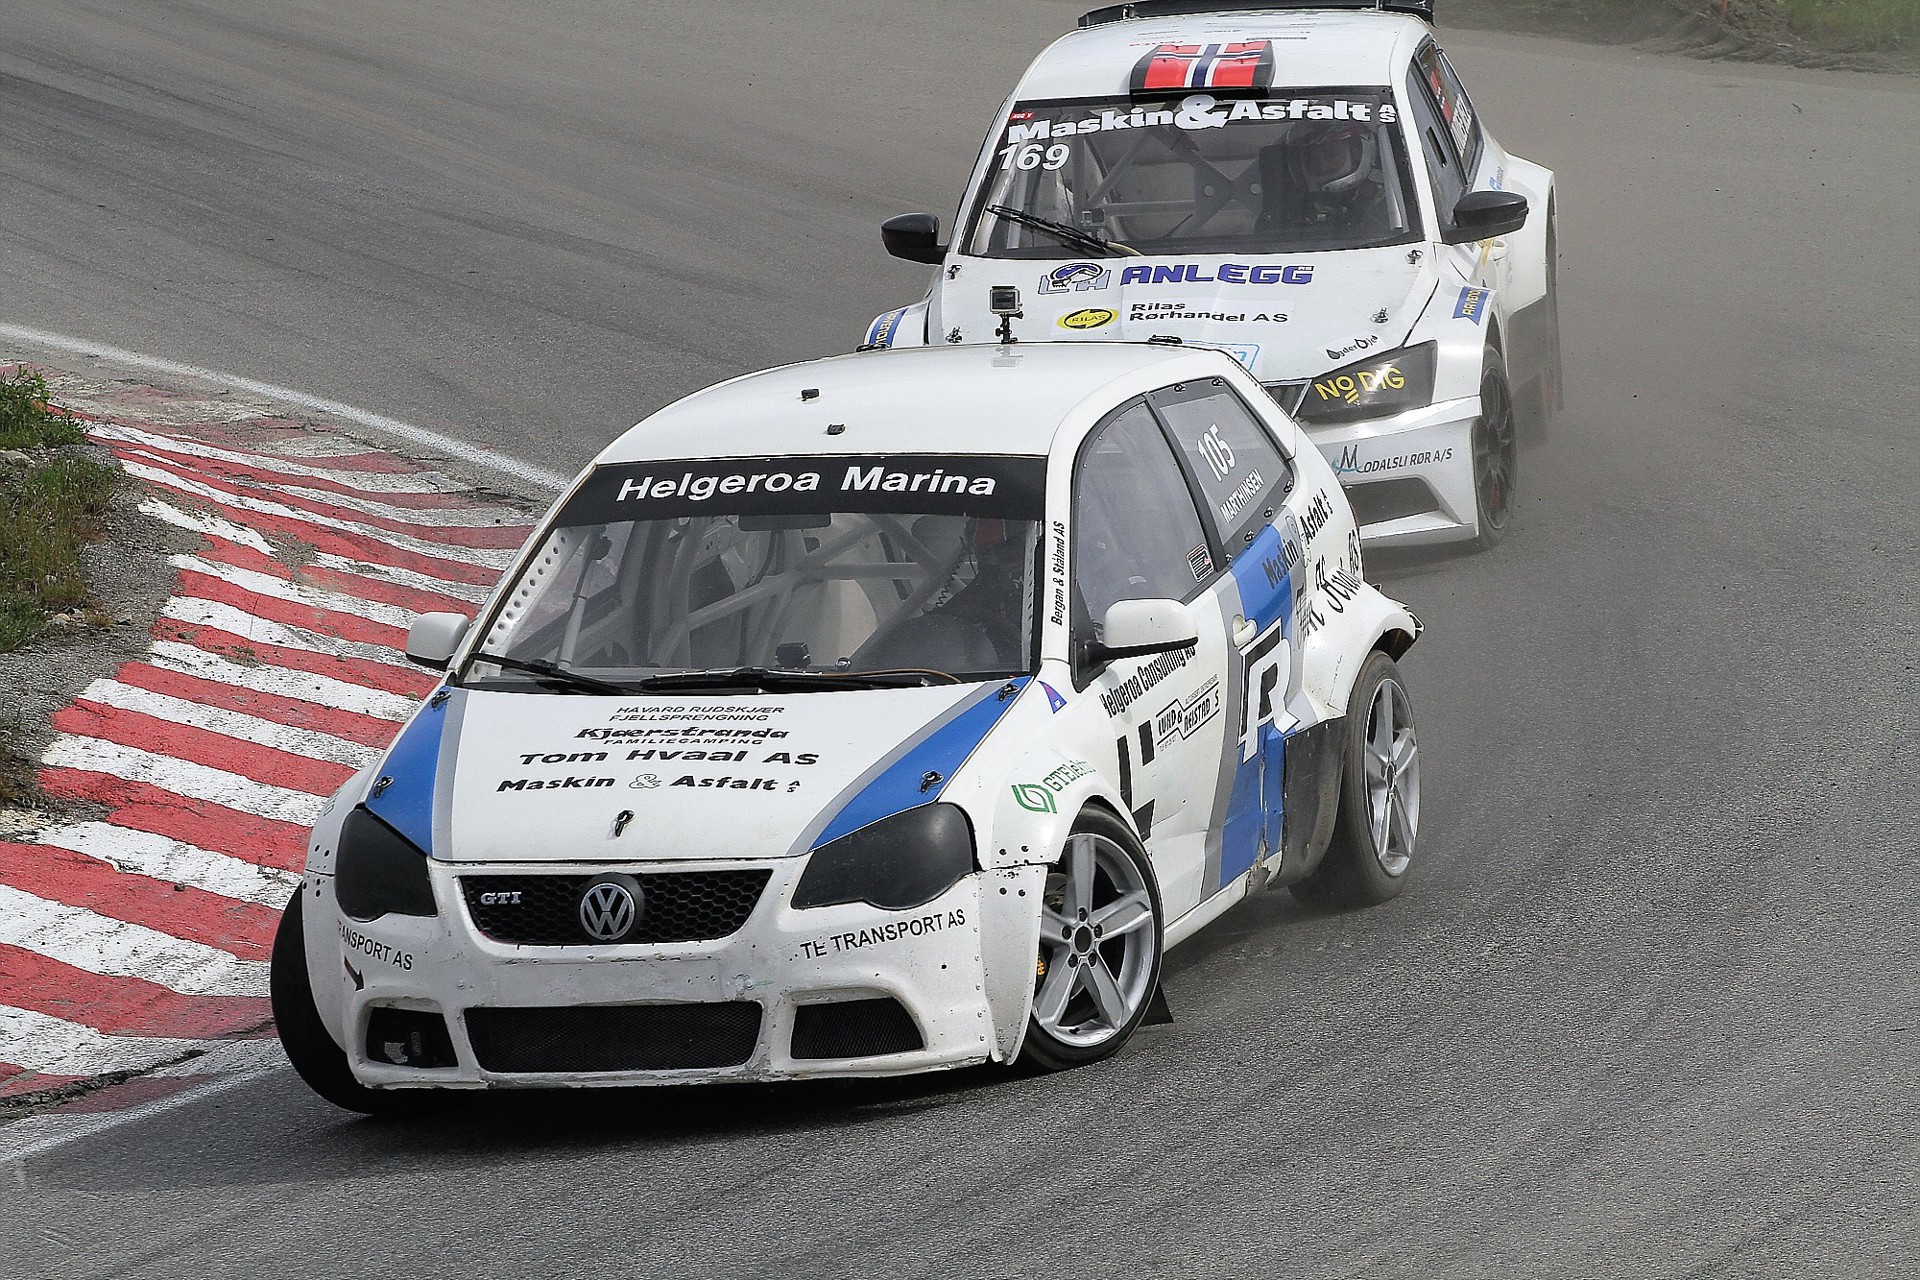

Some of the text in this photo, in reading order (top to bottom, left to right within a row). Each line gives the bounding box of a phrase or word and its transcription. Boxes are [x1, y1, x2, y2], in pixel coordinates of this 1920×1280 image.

[1007, 107, 1173, 144] Maskin
[1174, 94, 1229, 130] &
[1228, 99, 1371, 123] Asfalt
[998, 142, 1070, 171] 169
[1120, 263, 1314, 287] ANLEGG
[1130, 311, 1288, 322] Rørhandel AS
[1132, 303, 1186, 312] Rilas
[1071, 315, 1106, 324] RILAS
[1357, 367, 1405, 392] DIG
[1197, 424, 1236, 482] 105
[1410, 451, 1432, 466] RØR
[1433, 448, 1452, 463] A/S
[616, 466, 996, 501] Helgeroa Marina
[1219, 468, 1265, 524] MARTHINSEN
[1053, 521, 1065, 537] AS
[1262, 539, 1300, 590] Maskin
[1300, 494, 1329, 545] Asfalt
[1052, 577, 1064, 587] &
[1051, 588, 1066, 626] Bergan
[1099, 675, 1144, 718] Helgeroa
[688, 706, 786, 714] RUDSKJÆR
[1177, 710, 1183, 724] &
[574, 727, 790, 741] Kjærstranda
[520, 749, 820, 766] Tom Hvaal AS
[496, 776, 616, 792] Maskin
[628, 773, 662, 790] &
[669, 775, 779, 792] Asfalt
[480, 891, 522, 906] GTI
[800, 908, 966, 960] TE TRANSPORT AS
[392, 951, 413, 970] AS
